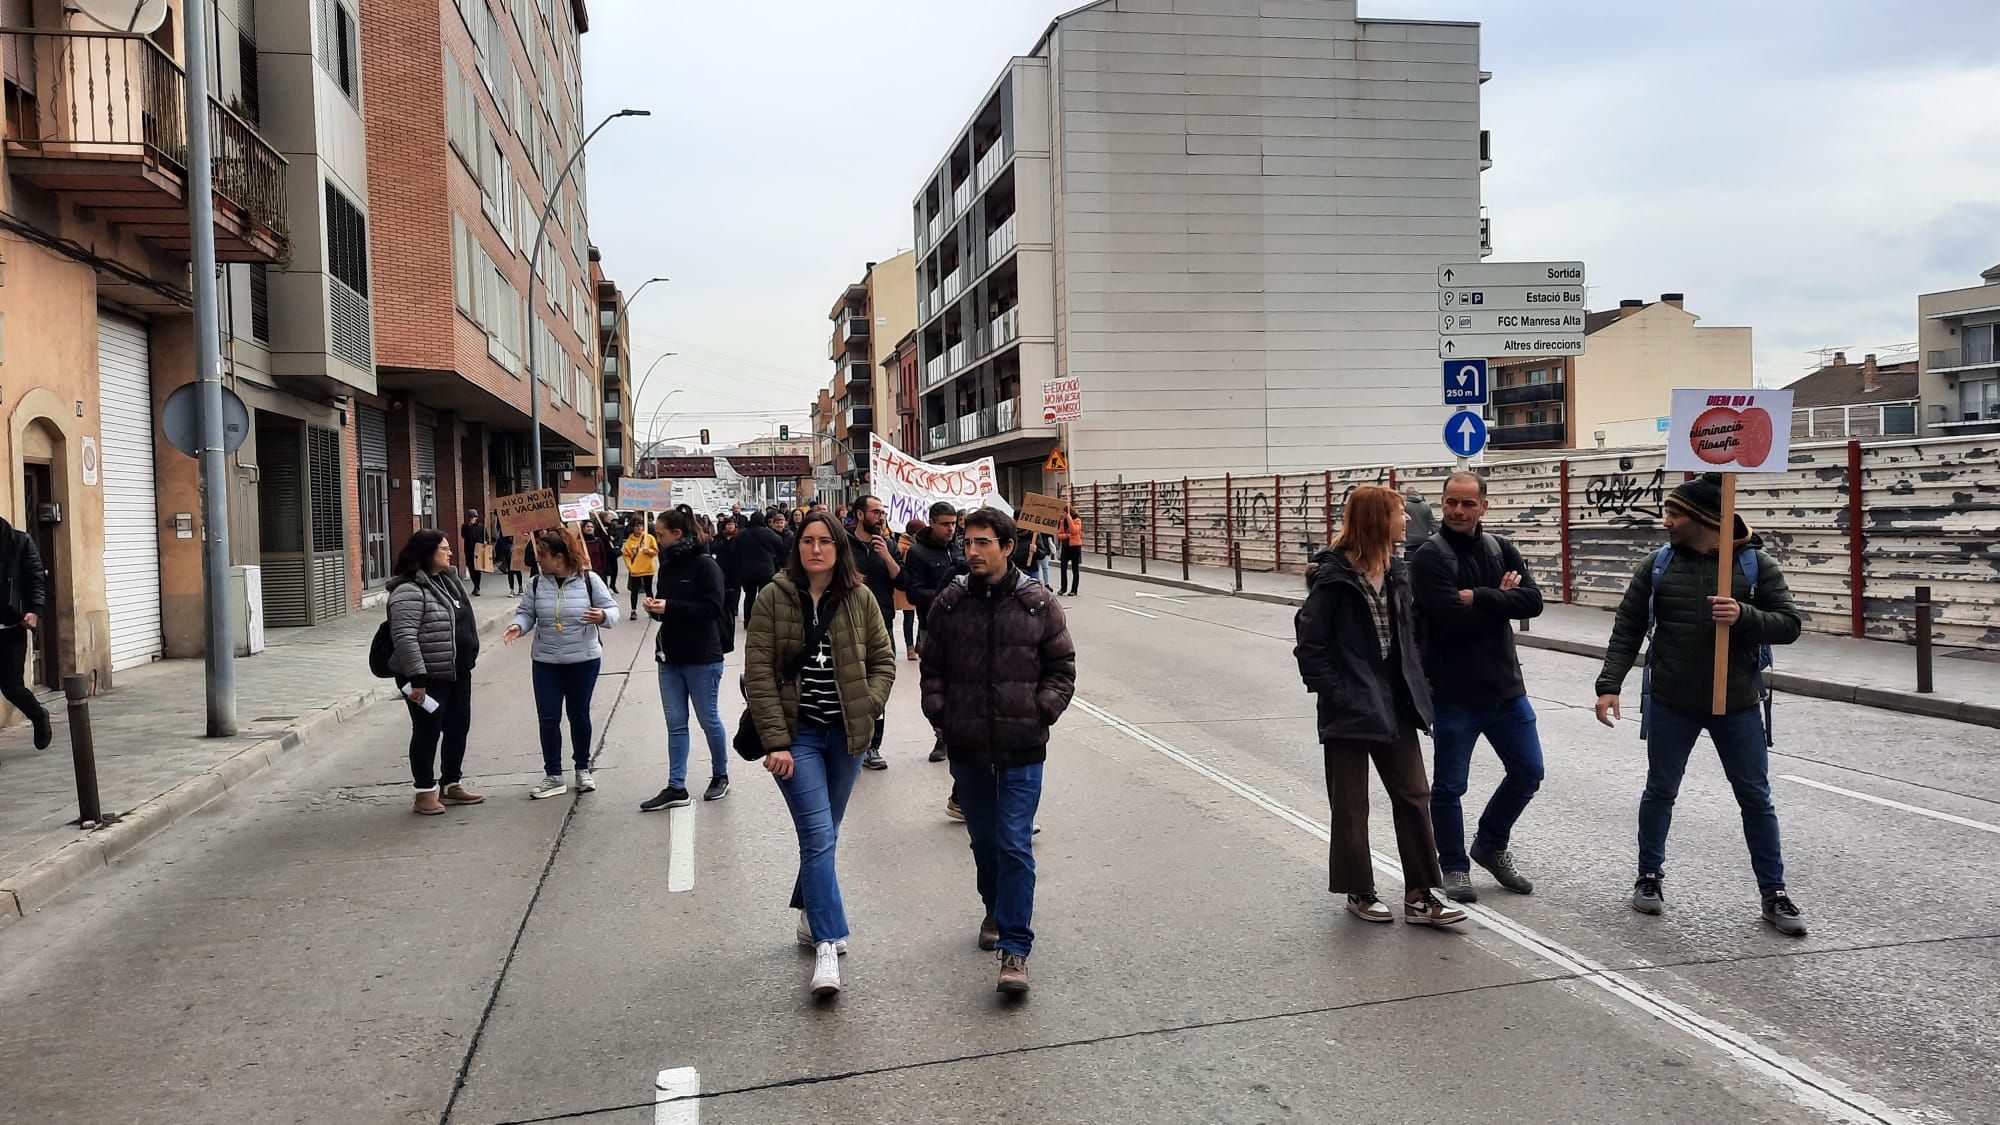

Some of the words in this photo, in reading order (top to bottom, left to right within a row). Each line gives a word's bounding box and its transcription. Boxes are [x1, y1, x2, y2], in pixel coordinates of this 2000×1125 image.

[1547, 267, 1581, 279] Sortida
[1526, 291, 1561, 303] Estació
[1563, 291, 1581, 302] Bus
[1498, 316, 1519, 327] FGC
[1521, 315, 1561, 326] Manresa
[1563, 314, 1581, 326] Alta
[1504, 339, 1532, 351] Altres
[1534, 337, 1582, 350] direccions
[1446, 389, 1464, 398] 250
[1706, 395, 1730, 406] DIEM
[1731, 395, 1746, 406] NO
[1746, 395, 1755, 406] A
[1689, 421, 1744, 438] eliminació
[1696, 436, 1740, 454] filosofia
[527, 493, 539, 502] NO
[541, 490, 554, 499] VA
[501, 508, 511, 517] DE
[514, 499, 555, 514] VACANCES
[1020, 512, 1034, 522] FOT
[1034, 515, 1041, 525] EL
